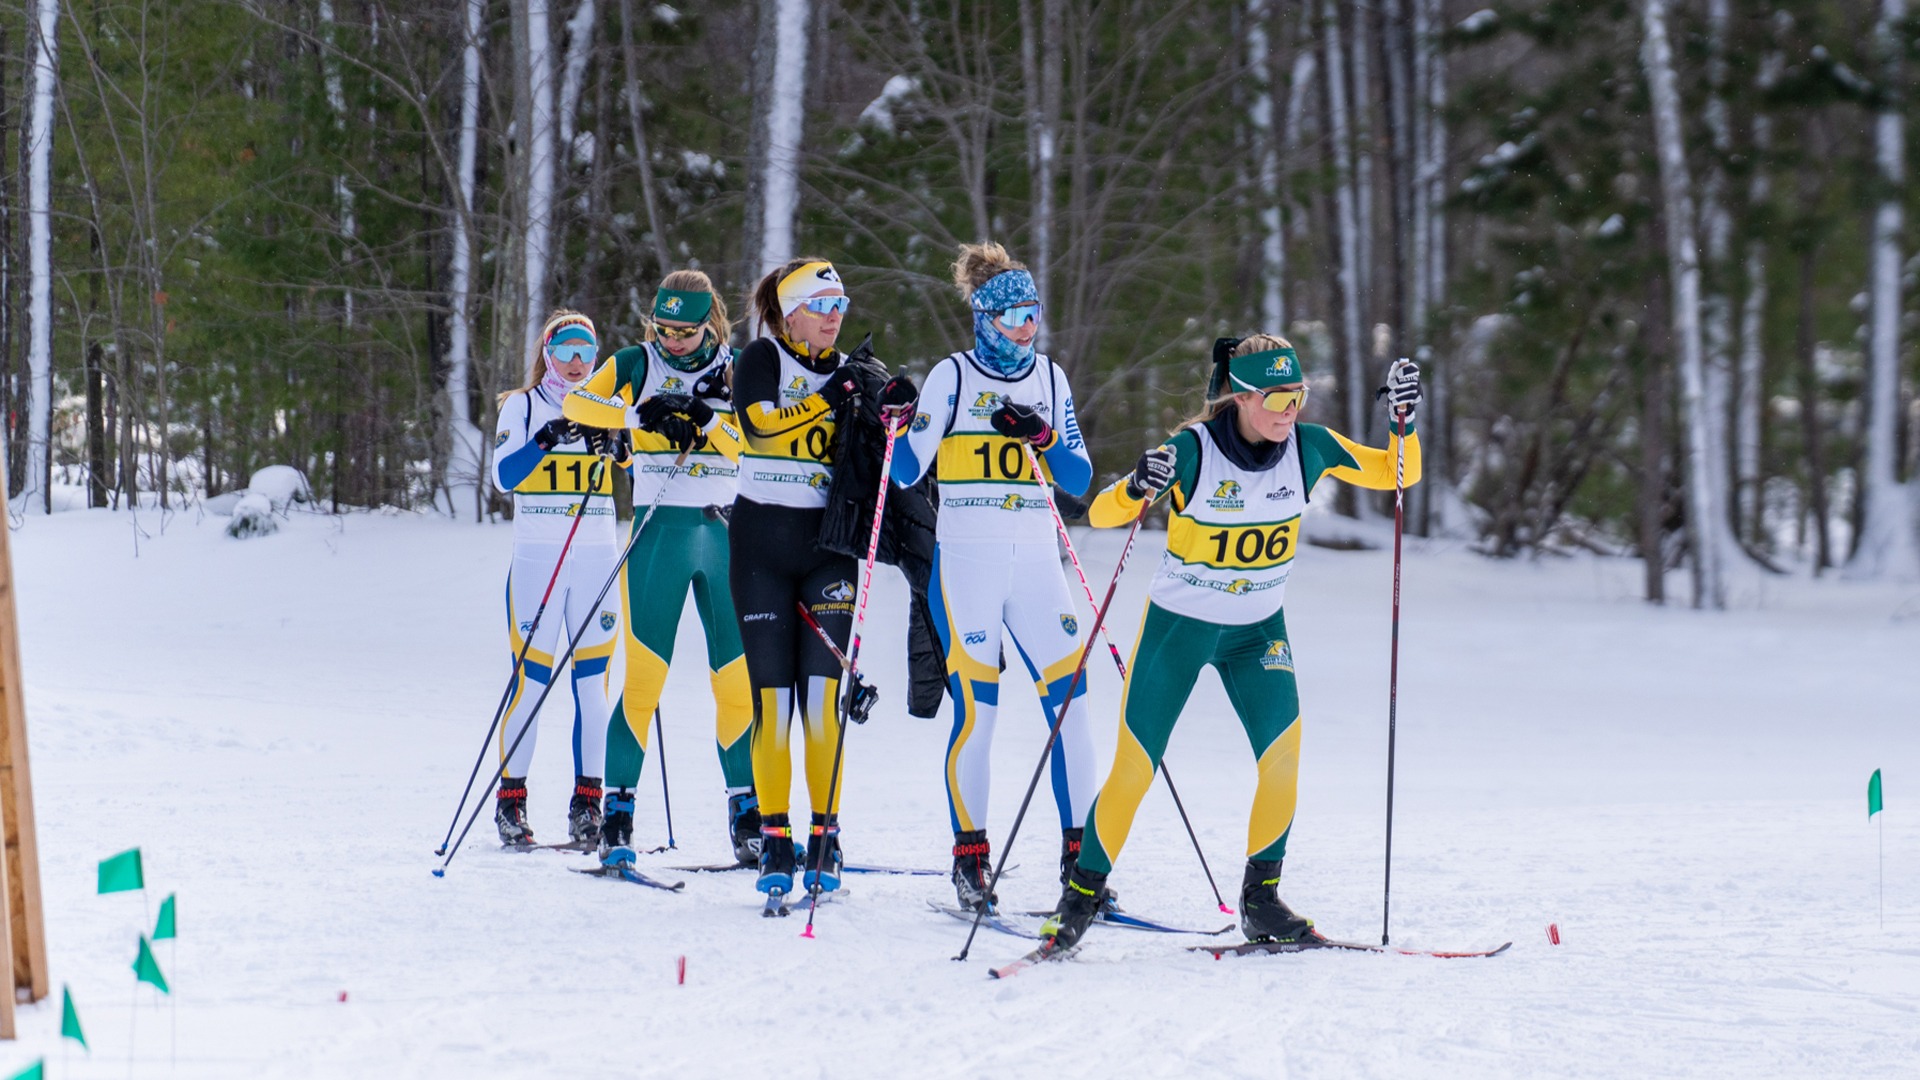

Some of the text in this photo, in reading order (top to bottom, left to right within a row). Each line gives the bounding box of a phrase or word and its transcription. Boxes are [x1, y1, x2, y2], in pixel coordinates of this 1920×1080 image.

[1265, 367, 1293, 377] NMU
[542, 460, 605, 492] 110
[944, 497, 1005, 508] NORTHERN
[521, 506, 569, 516] NORTHERN
[1209, 524, 1290, 564] 106
[811, 602, 850, 612] MICHIGAN
[743, 612, 769, 623] CRAFT
